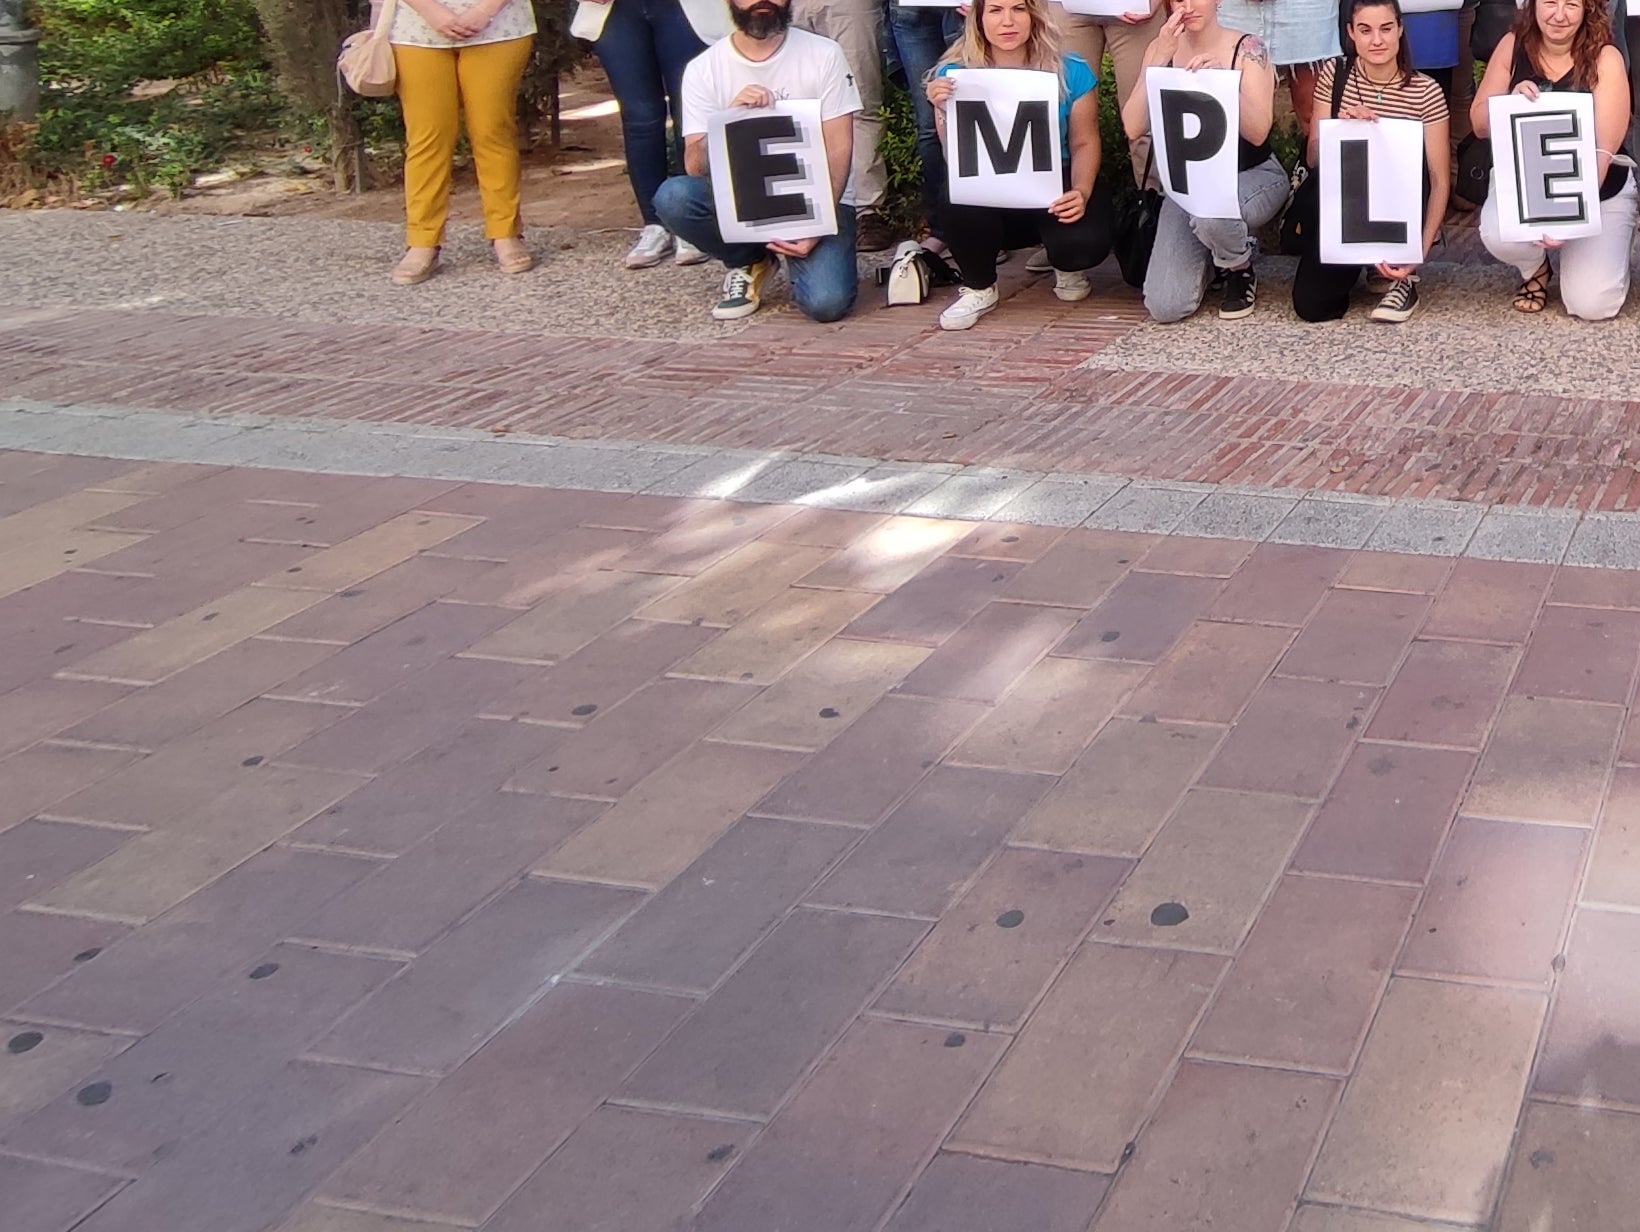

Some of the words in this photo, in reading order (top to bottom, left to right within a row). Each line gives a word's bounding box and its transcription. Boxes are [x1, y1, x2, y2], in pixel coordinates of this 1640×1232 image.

[725, 115, 816, 227] E
[957, 99, 1054, 177] M
[1160, 89, 1228, 195] P
[1511, 110, 1584, 224] E
[1340, 139, 1408, 244] L
